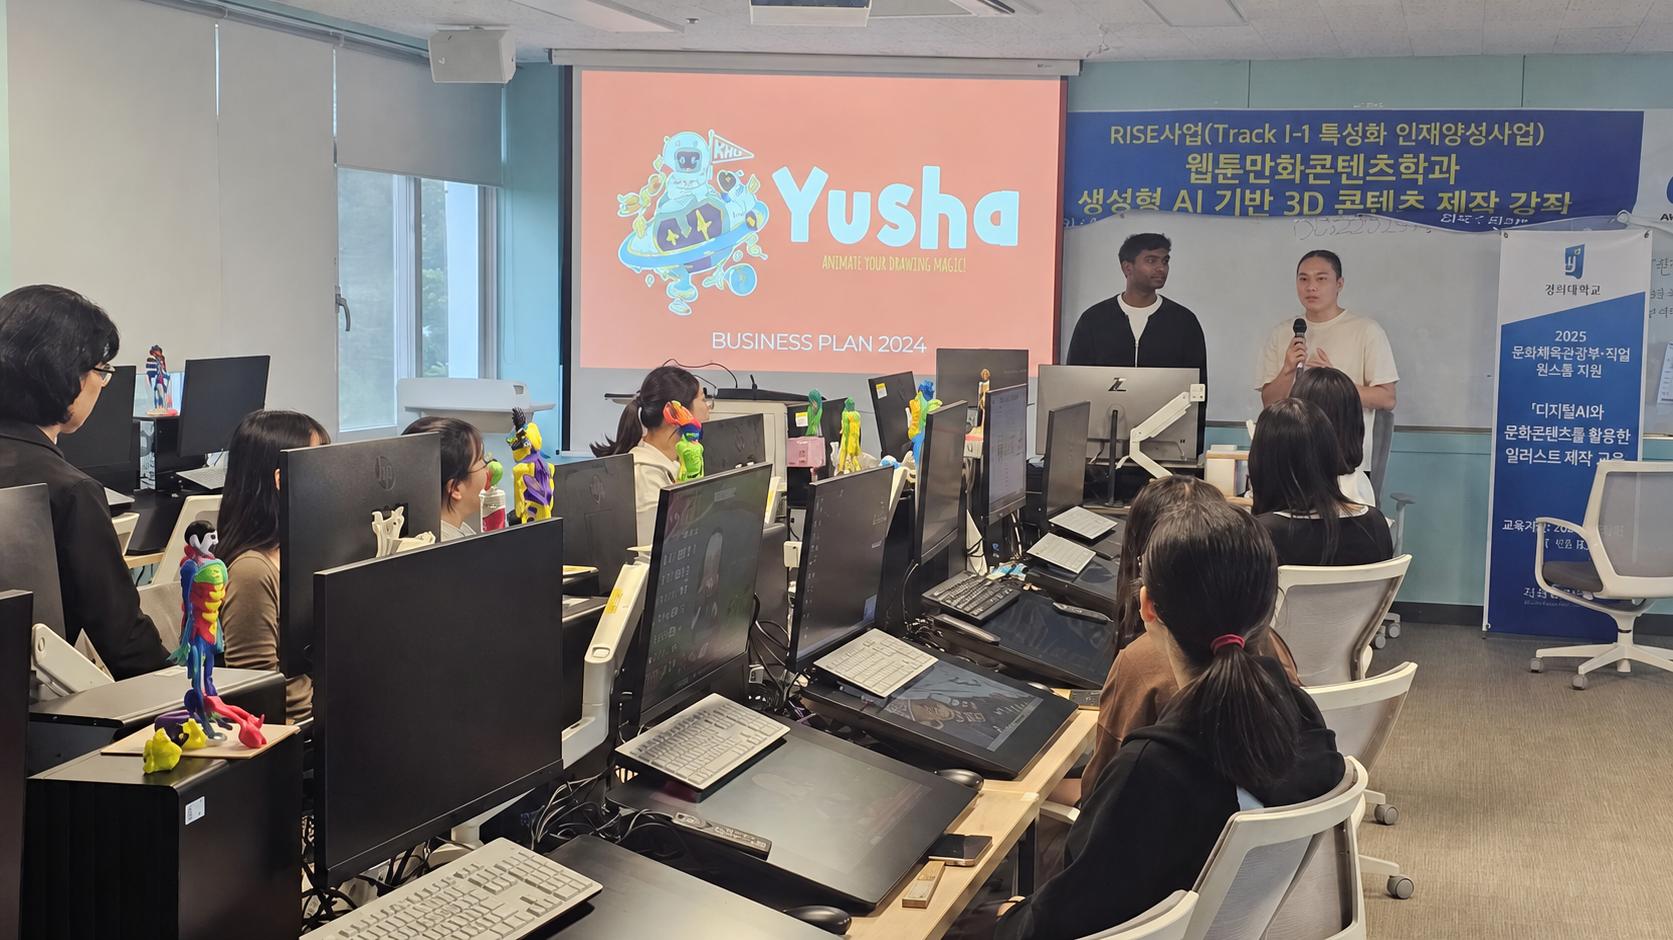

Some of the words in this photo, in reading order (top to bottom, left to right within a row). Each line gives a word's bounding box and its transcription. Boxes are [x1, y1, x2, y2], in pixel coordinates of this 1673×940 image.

[1110, 122, 1277, 146] RISE사업(Track
[1319, 122, 1387, 146] 특성화
[1396, 122, 1545, 146] 인재양성사업)
[1185, 153, 1461, 185] 웹툰만화콘텐츠학과
[771, 165, 1020, 250] Yusha
[1078, 187, 1162, 215] 생성형
[1172, 189, 1203, 214] AI
[1214, 188, 1274, 217] 기반
[1283, 191, 1324, 217] 3D
[1436, 190, 1500, 214] 제작
[1509, 191, 1573, 216] 강좌
[821, 254, 862, 271] ANIMATE
[864, 256, 887, 271] YOUR
[889, 256, 931, 272] DRAWING
[933, 257, 967, 273] MAGIC!
[712, 331, 813, 351] BUSINESS
[818, 334, 873, 352] PLAN
[878, 336, 927, 354] 2024
[1555, 330, 1587, 342] 2025
[1577, 364, 1602, 378] 지원
[1504, 425, 1585, 444] 문화콘텐츠를
[1588, 427, 1631, 445] 활용한
[1505, 447, 1562, 465] 일러스트
[1564, 449, 1593, 467] 제작
